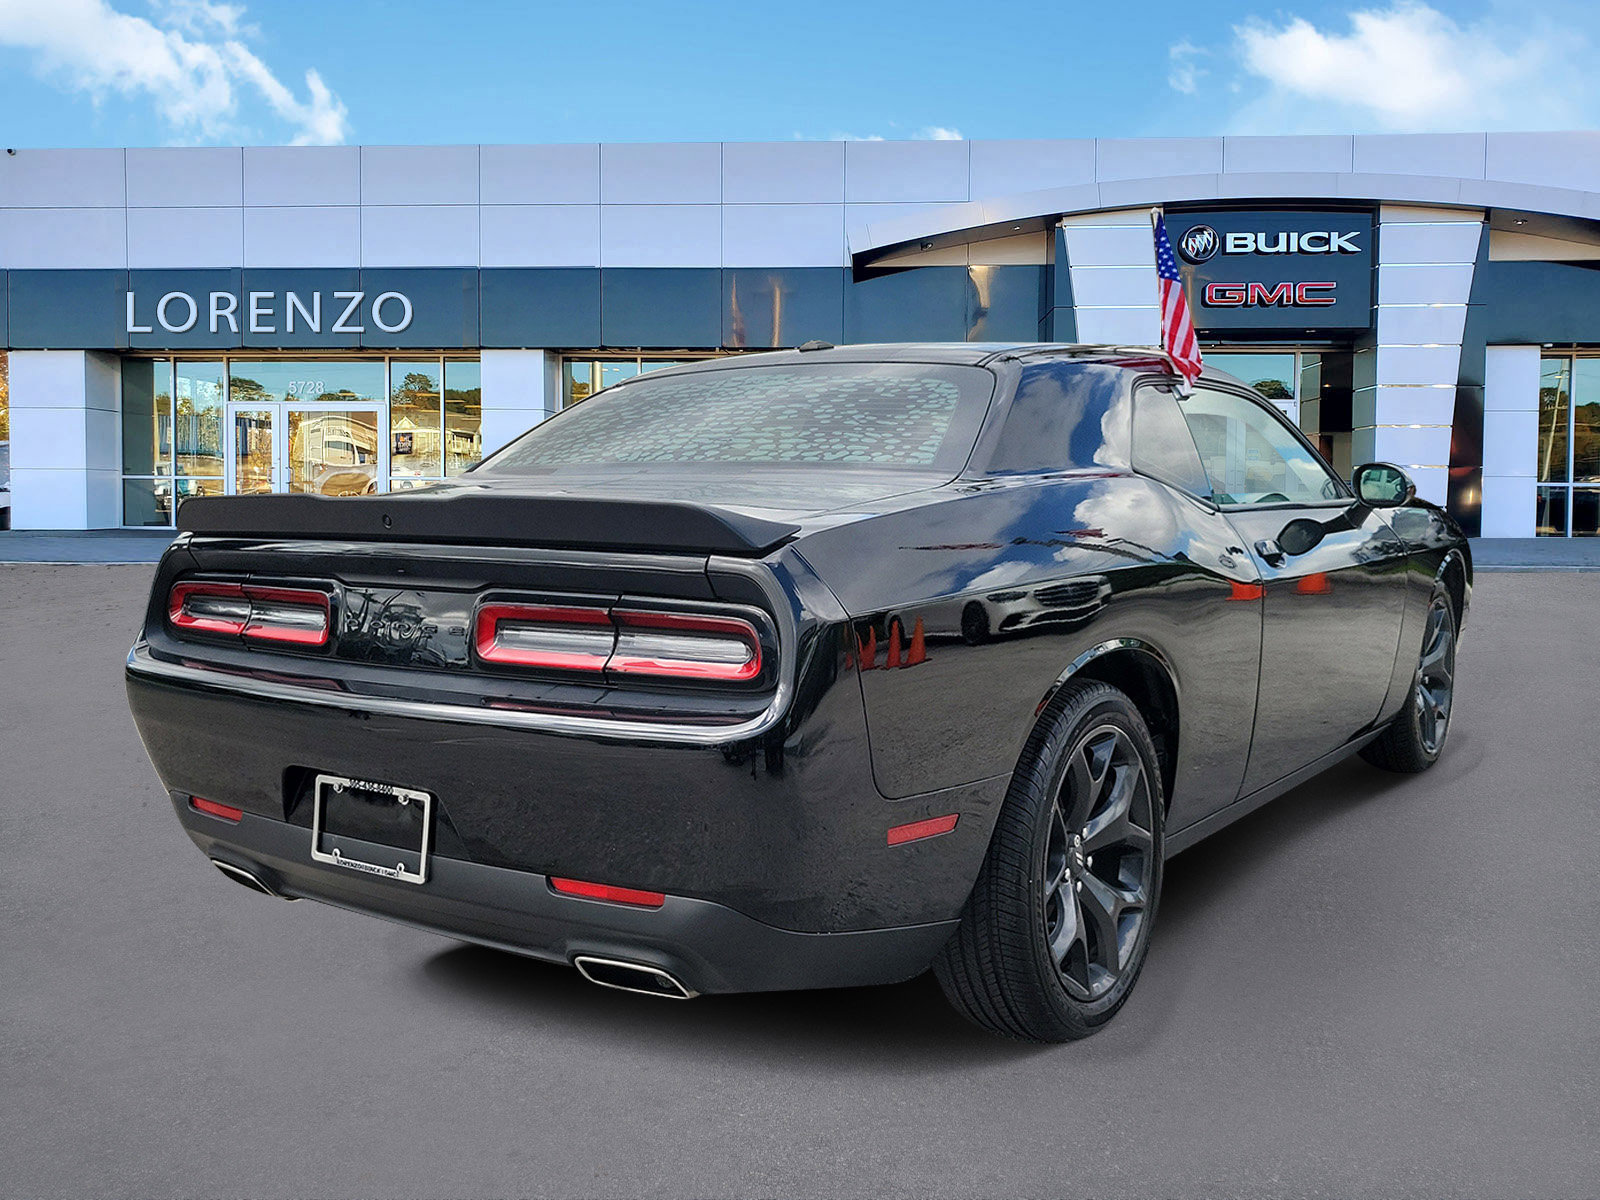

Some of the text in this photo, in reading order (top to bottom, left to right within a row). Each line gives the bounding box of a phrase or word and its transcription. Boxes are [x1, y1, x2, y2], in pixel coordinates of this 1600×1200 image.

[1225, 231, 1361, 253] BUICK
[1206, 281, 1337, 306] GMC
[126, 291, 413, 333] LORENZO
[288, 380, 325, 394] 5728
